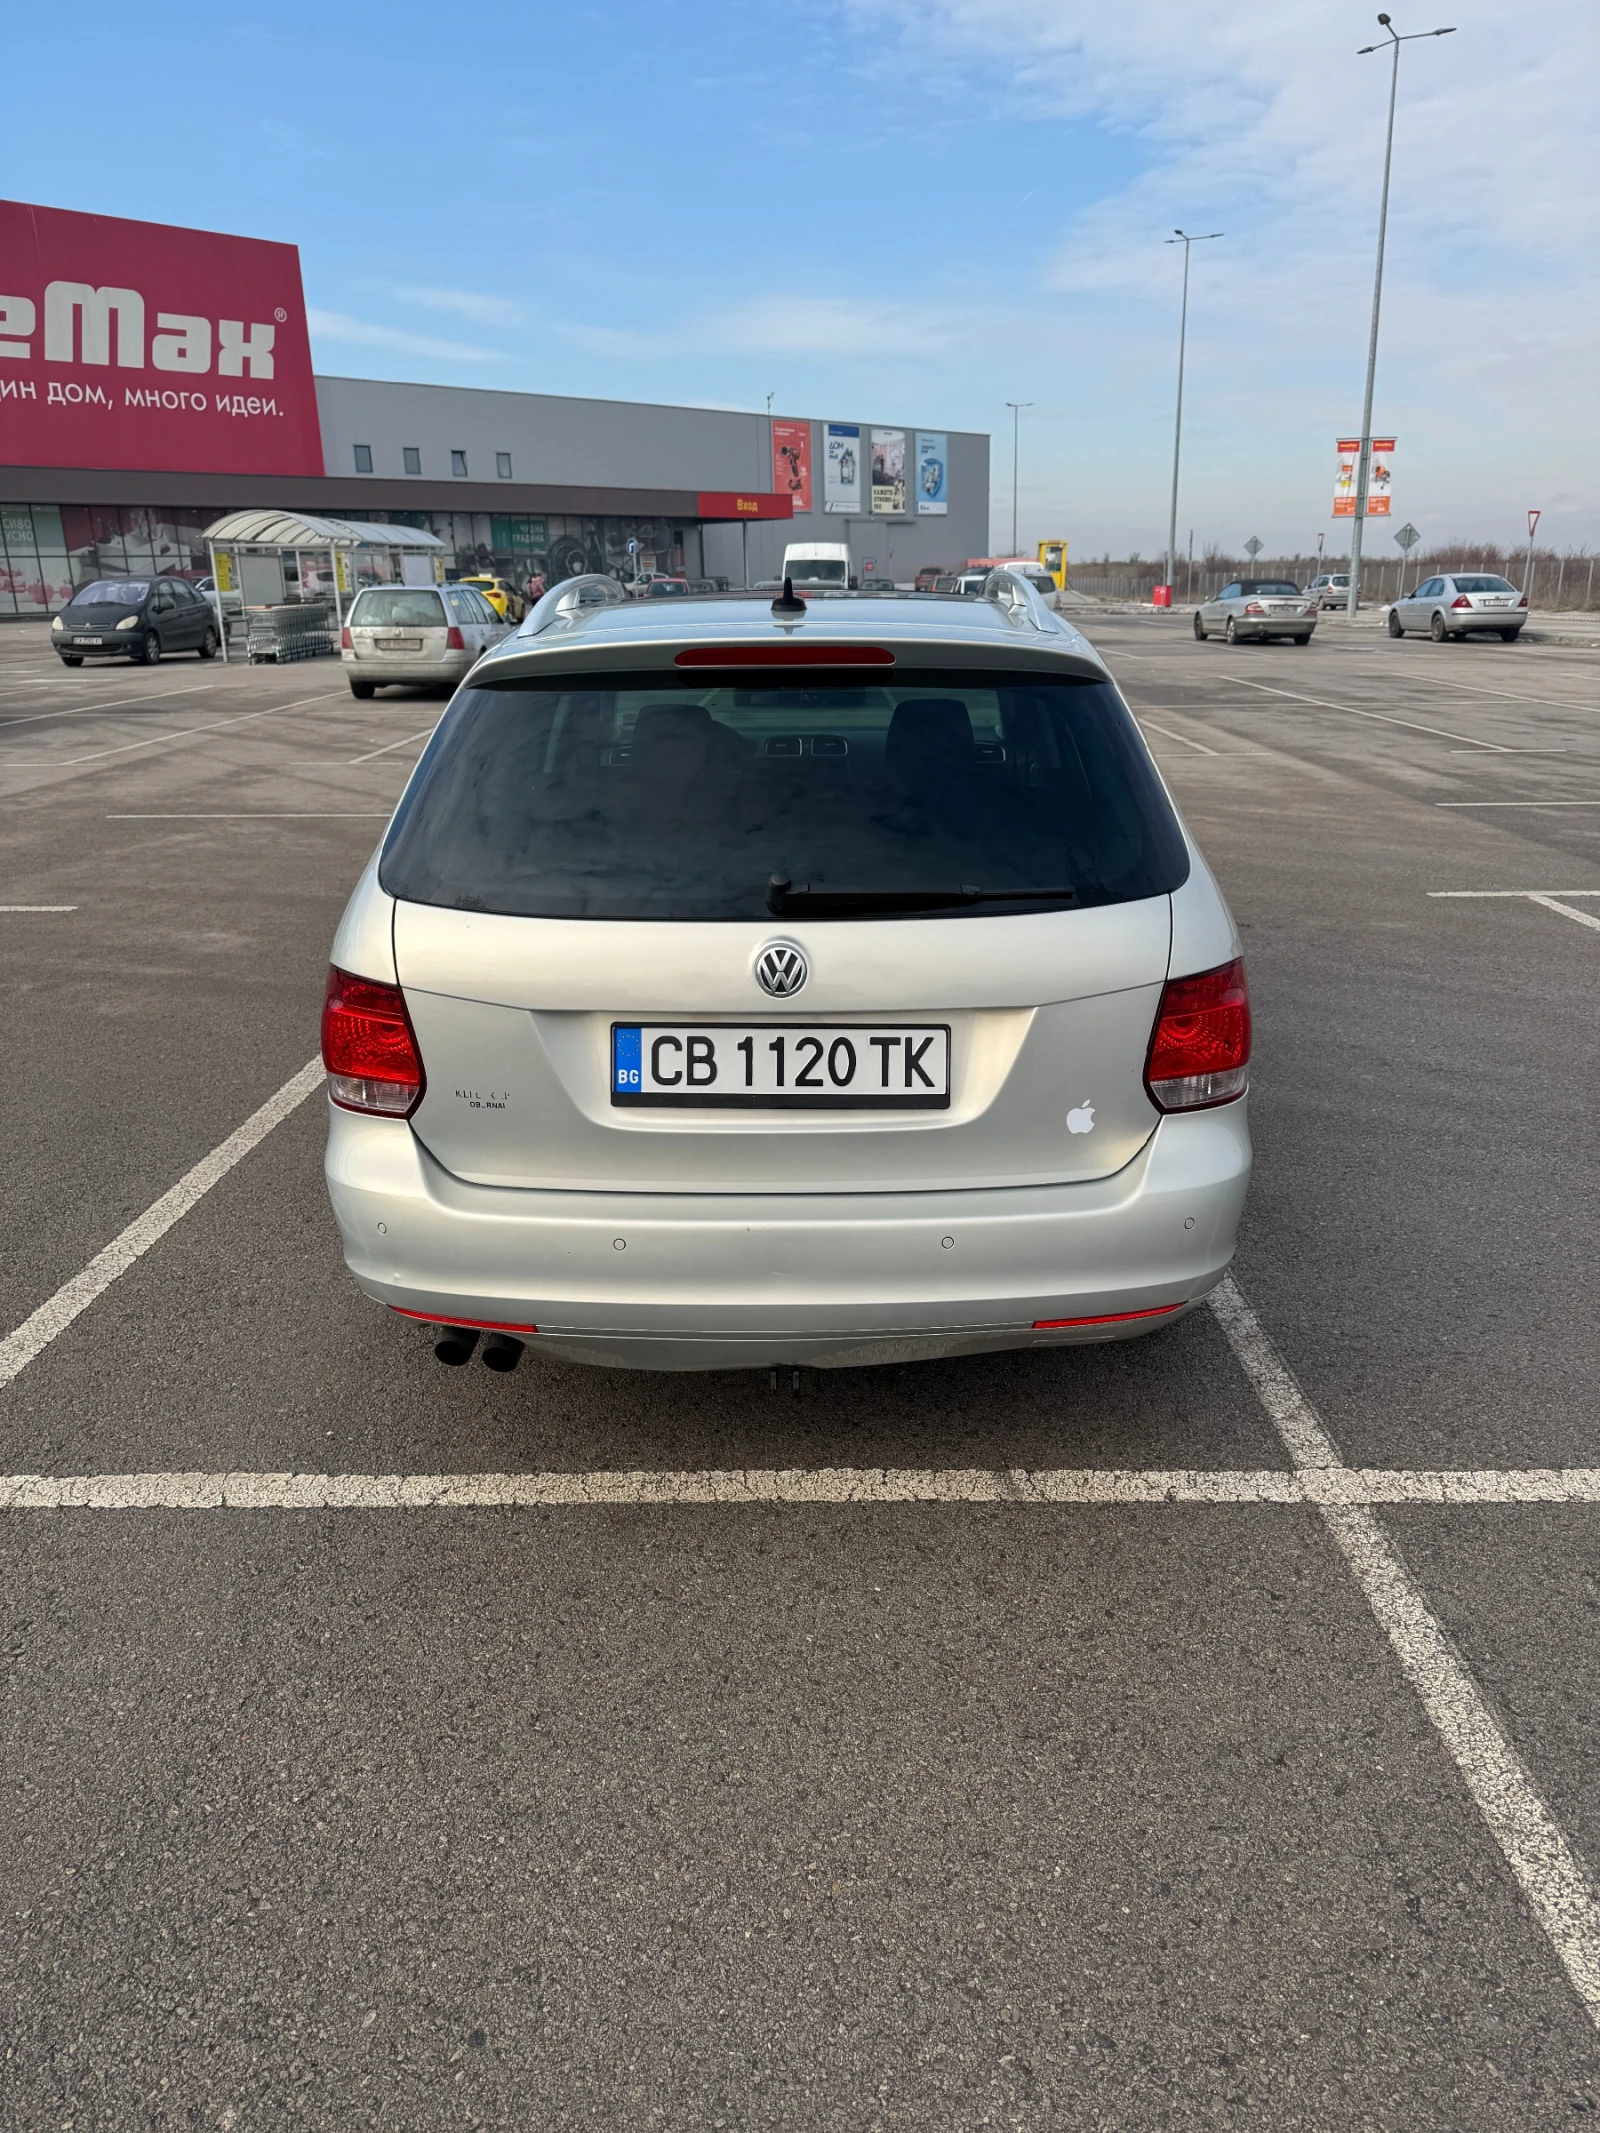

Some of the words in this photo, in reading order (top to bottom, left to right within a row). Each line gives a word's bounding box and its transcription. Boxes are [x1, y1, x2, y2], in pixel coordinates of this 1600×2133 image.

[0, 379, 37, 400] ин
[47, 381, 114, 410] дом,
[124, 387, 207, 412] много
[215, 394, 284, 418] идеи.
[737, 499, 758, 513] Вход
[0, 530, 34, 542] УСНО
[651, 1035, 718, 1087] CB
[737, 1036, 857, 1088] 1120
[869, 1037, 936, 1088] TK
[617, 1069, 640, 1085] BG
